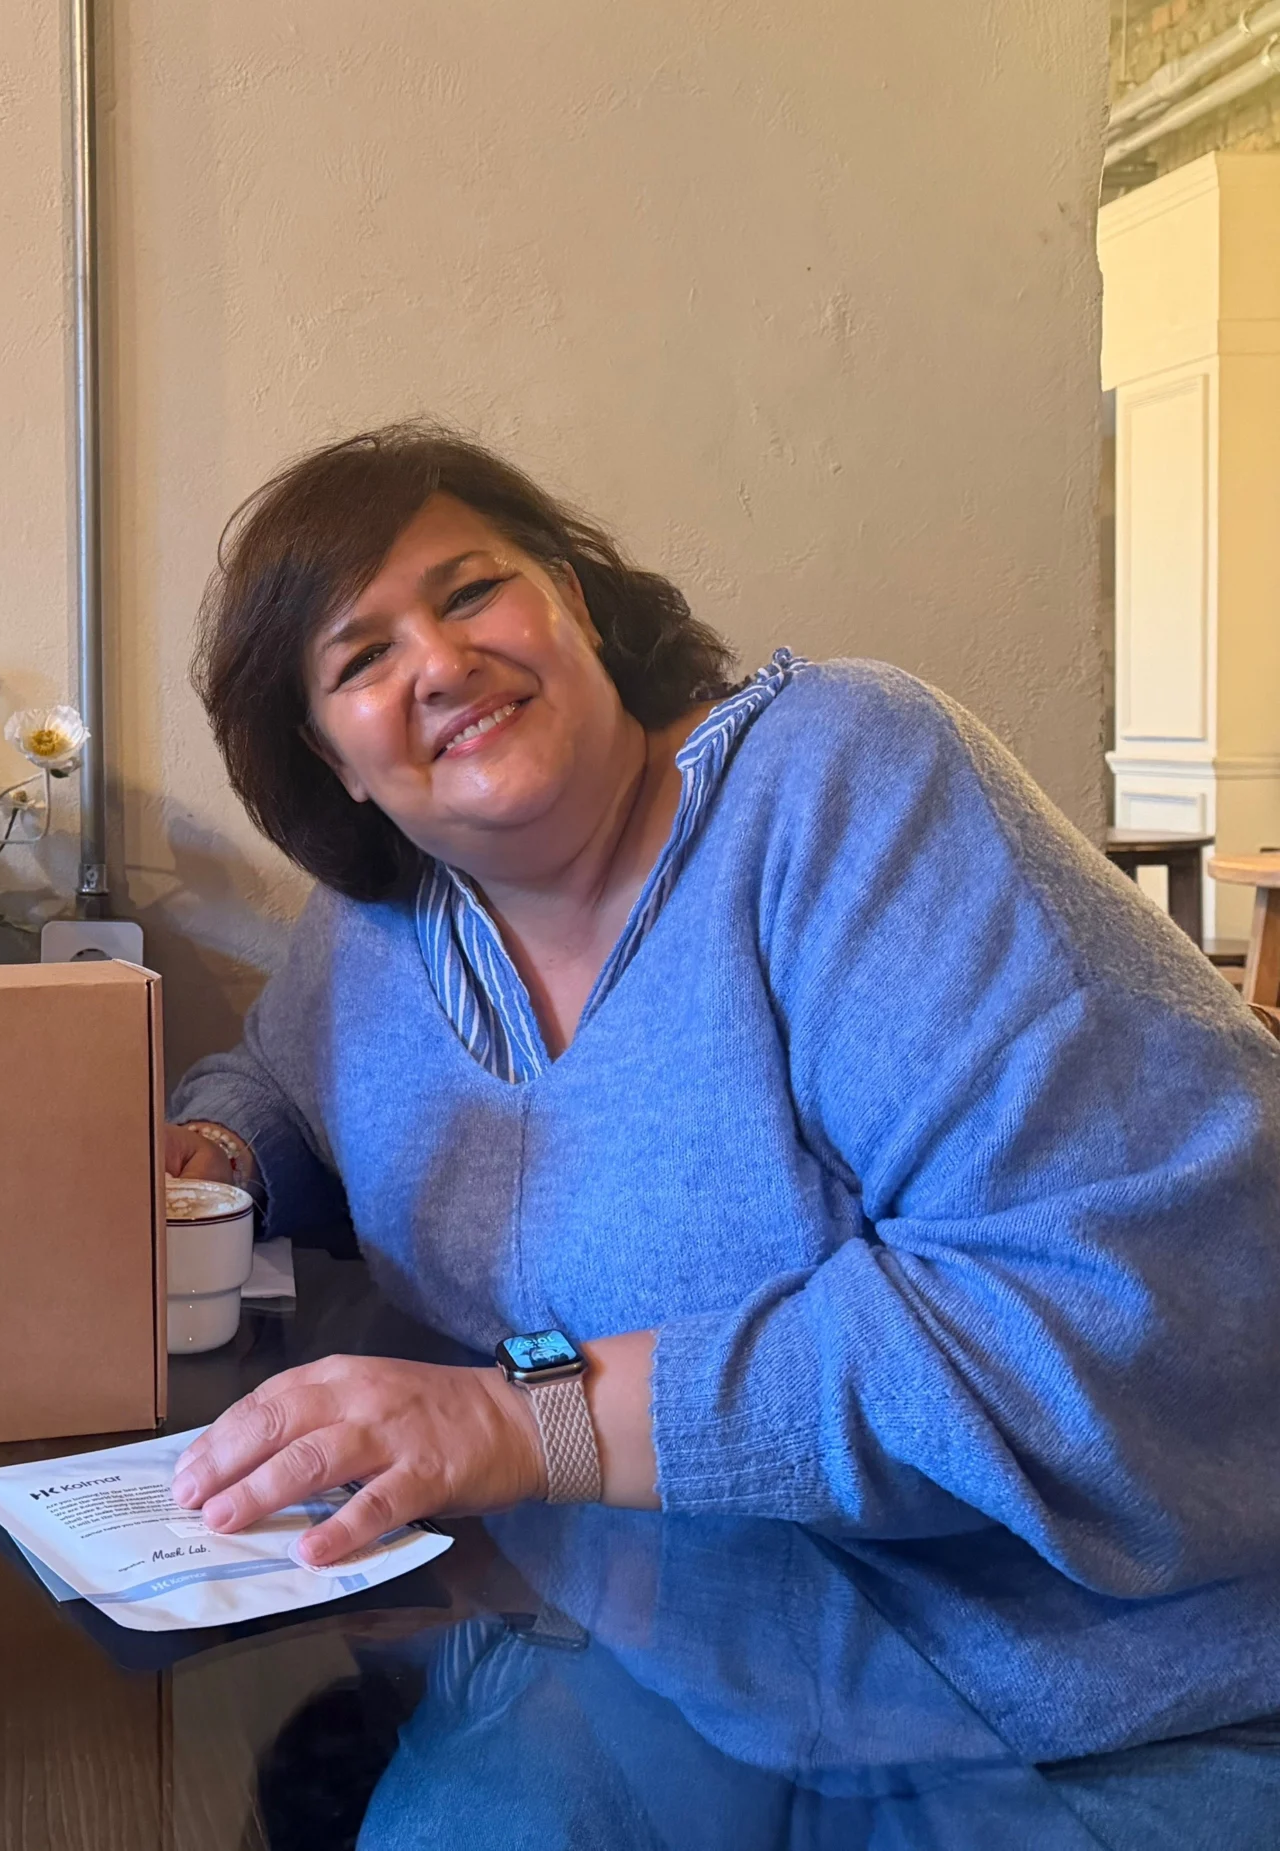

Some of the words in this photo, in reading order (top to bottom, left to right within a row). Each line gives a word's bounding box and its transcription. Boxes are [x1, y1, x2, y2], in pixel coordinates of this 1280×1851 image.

[60, 1475, 122, 1492] Kolmar
[59, 1503, 79, 1511] make
[152, 1547, 185, 1562] Mask
[188, 1544, 211, 1555] Lab.
